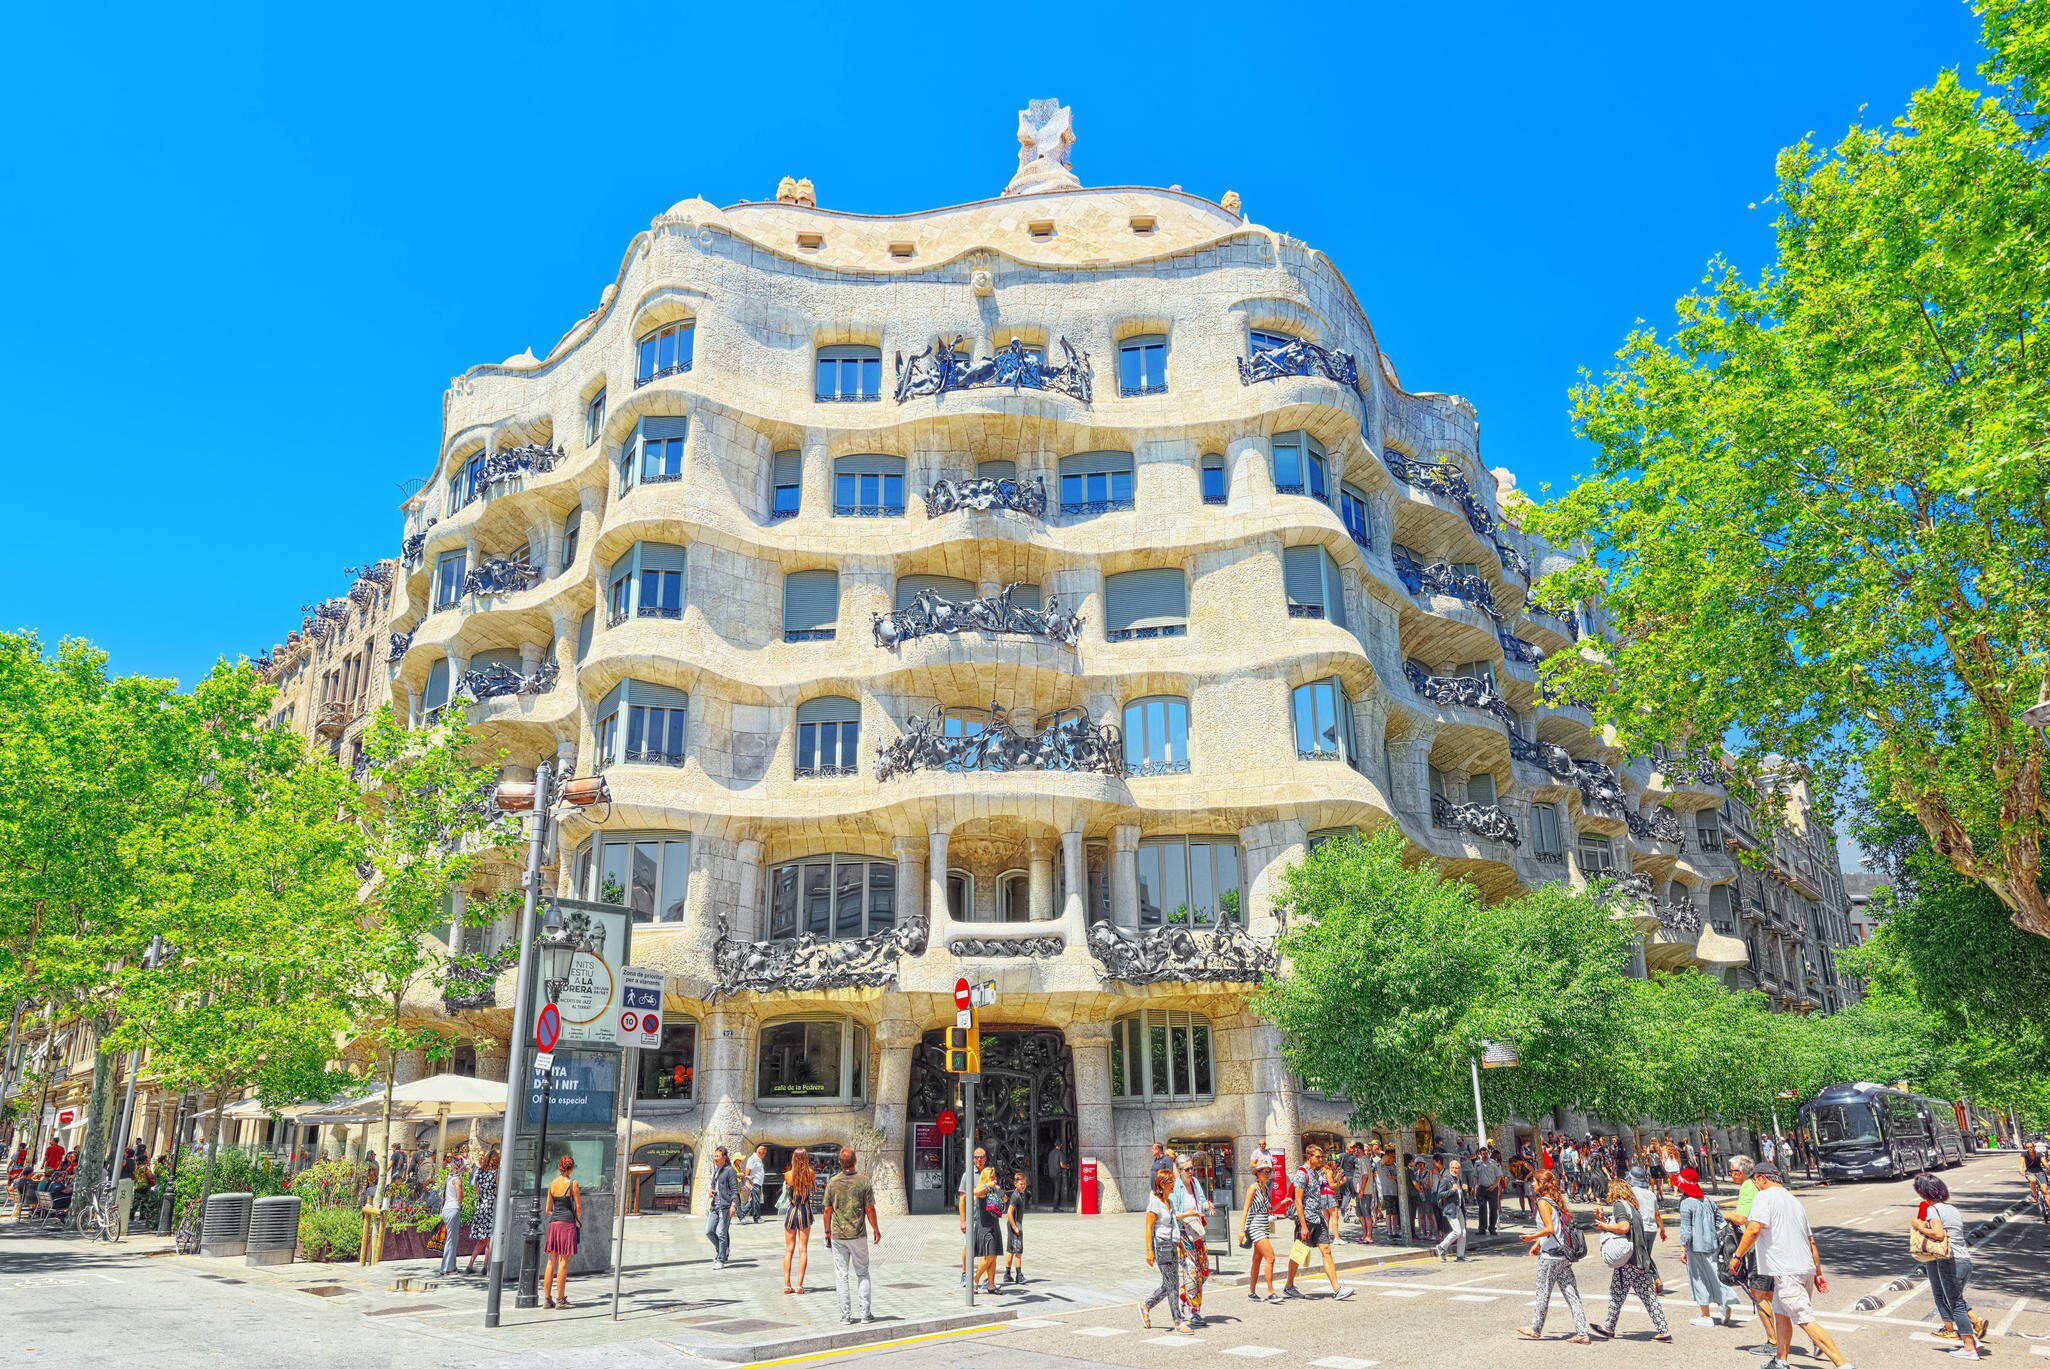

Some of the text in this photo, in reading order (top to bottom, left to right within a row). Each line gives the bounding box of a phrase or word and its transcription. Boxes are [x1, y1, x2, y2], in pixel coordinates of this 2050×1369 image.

[576, 961, 594, 969] NITS
[562, 985, 592, 993] DRERA
[535, 1066, 567, 1077] VIITA
[562, 1080, 579, 1090] NIT
[558, 1096, 587, 1105] especial
